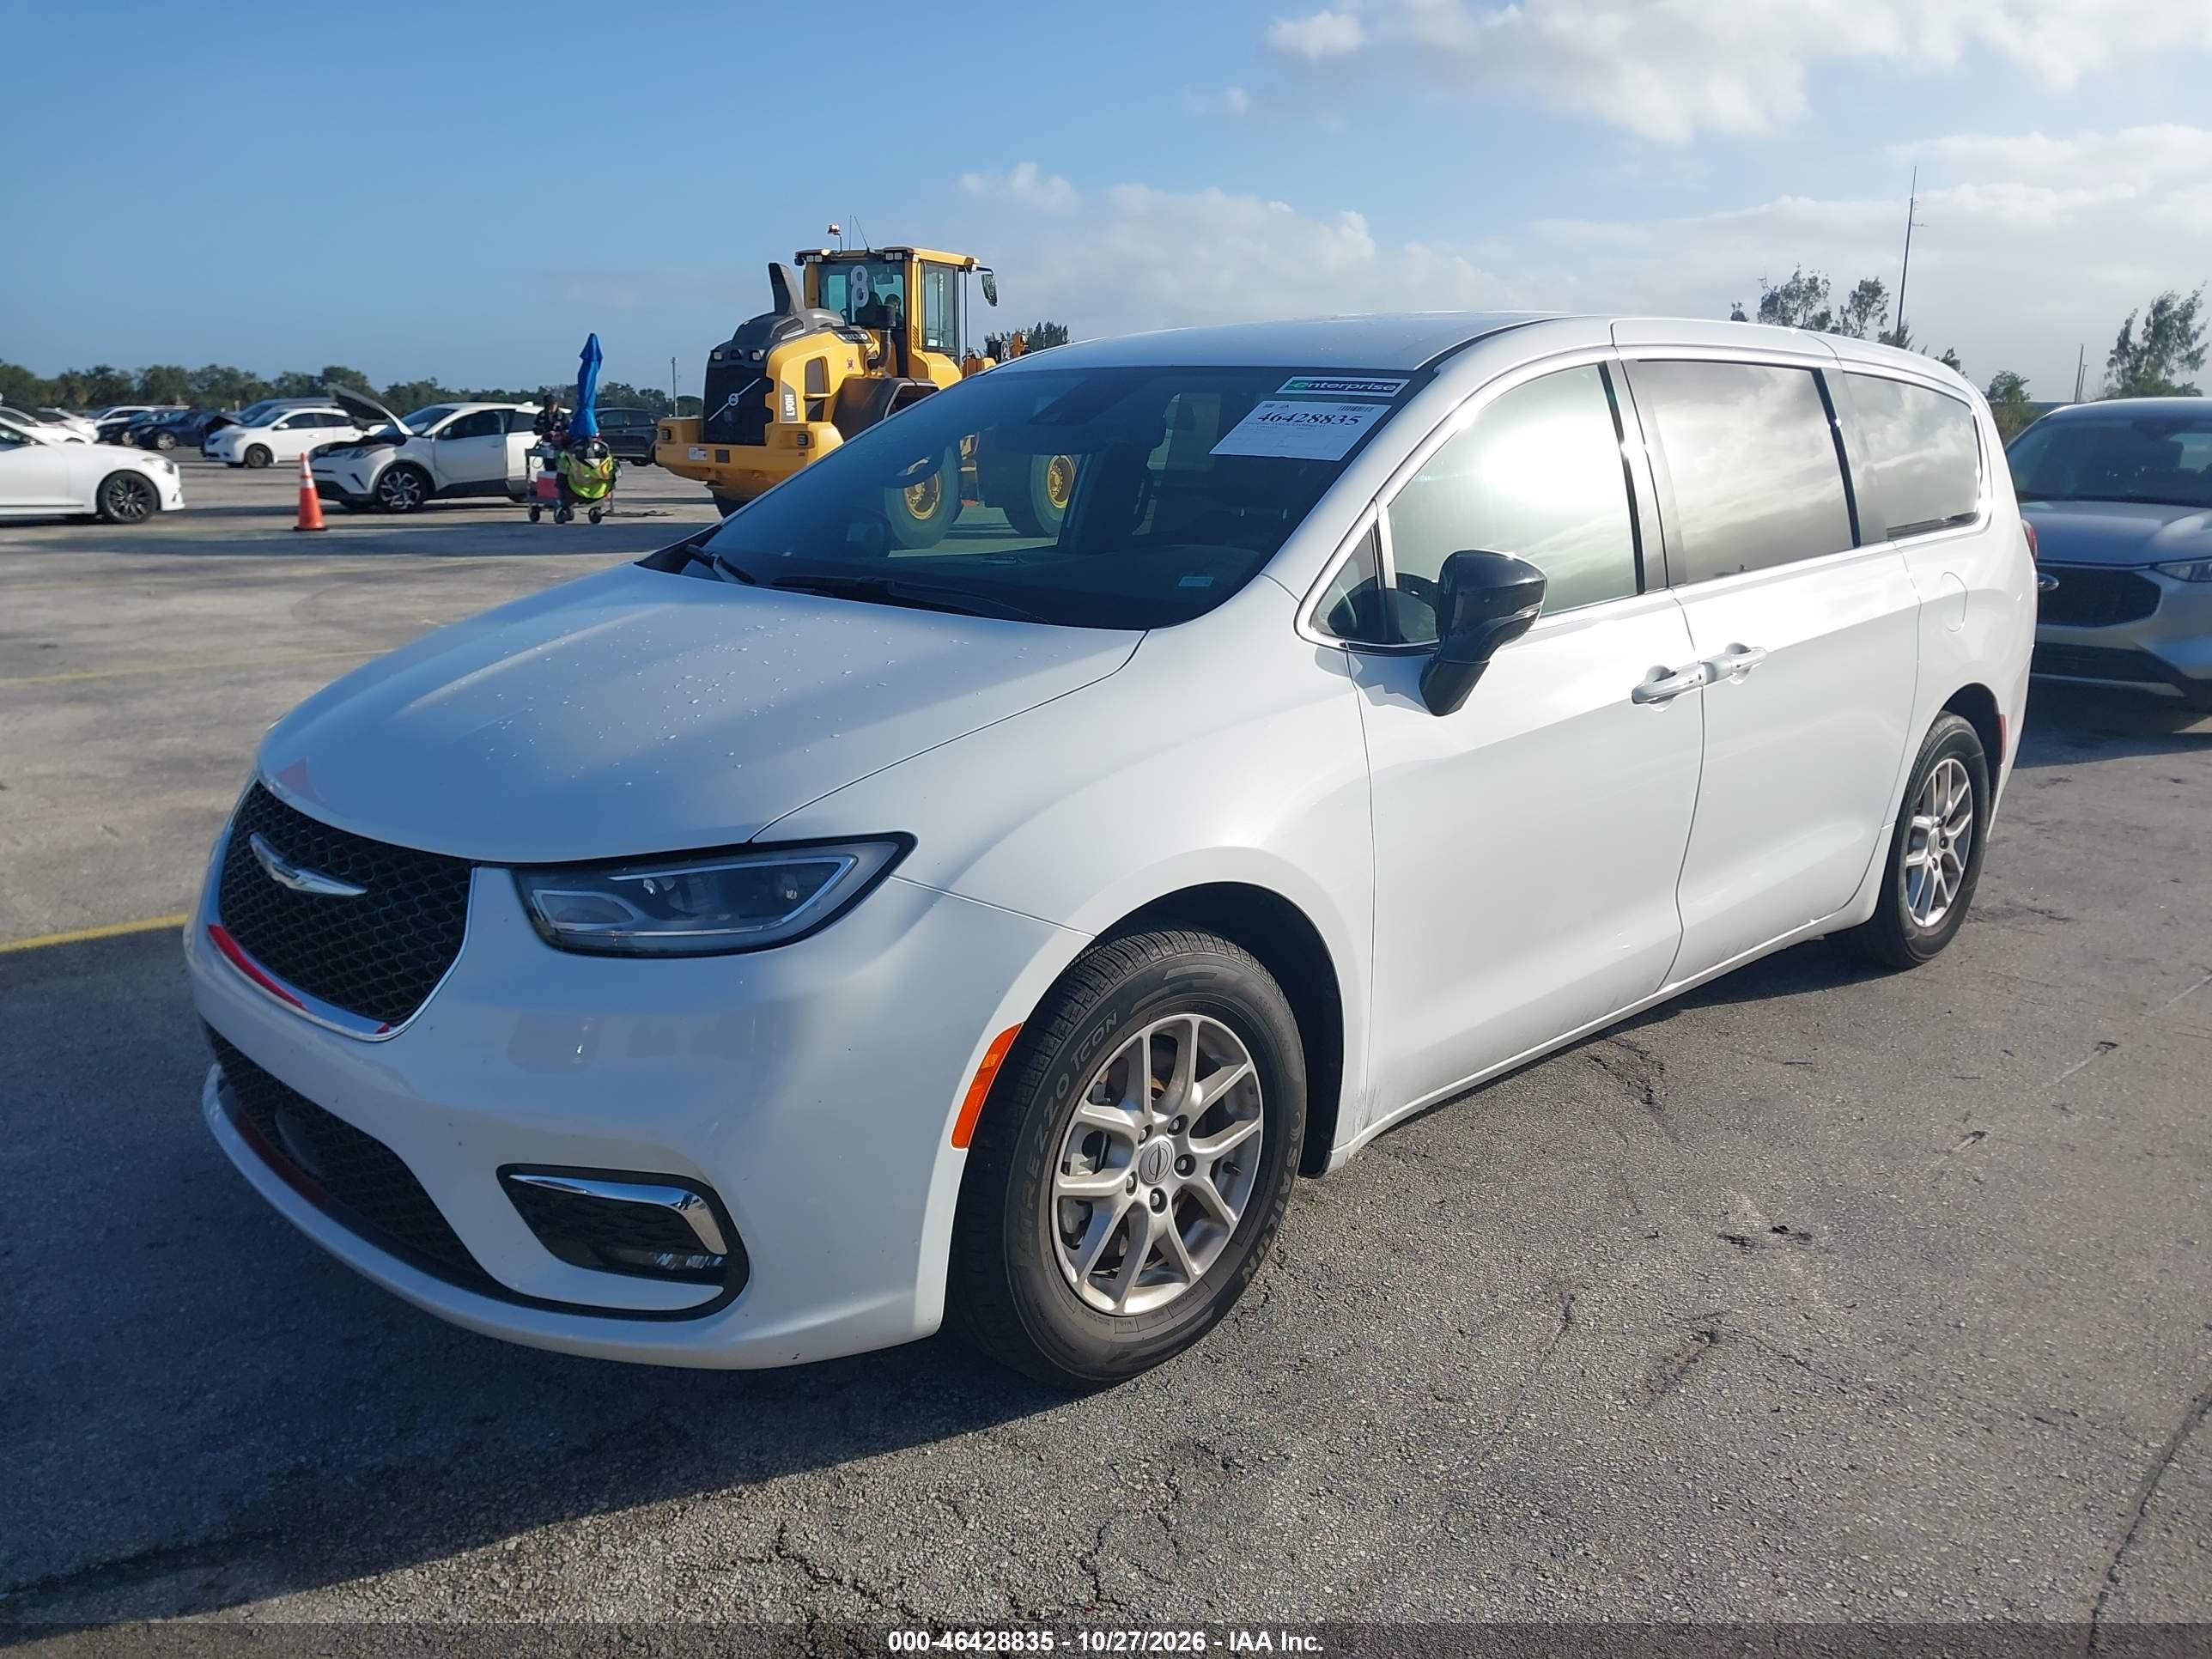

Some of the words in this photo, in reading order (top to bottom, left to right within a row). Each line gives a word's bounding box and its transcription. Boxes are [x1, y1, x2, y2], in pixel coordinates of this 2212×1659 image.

[1290, 380, 1397, 392] enterprise
[784, 394, 796, 416] L90H
[1257, 411, 1363, 426] 46428835
